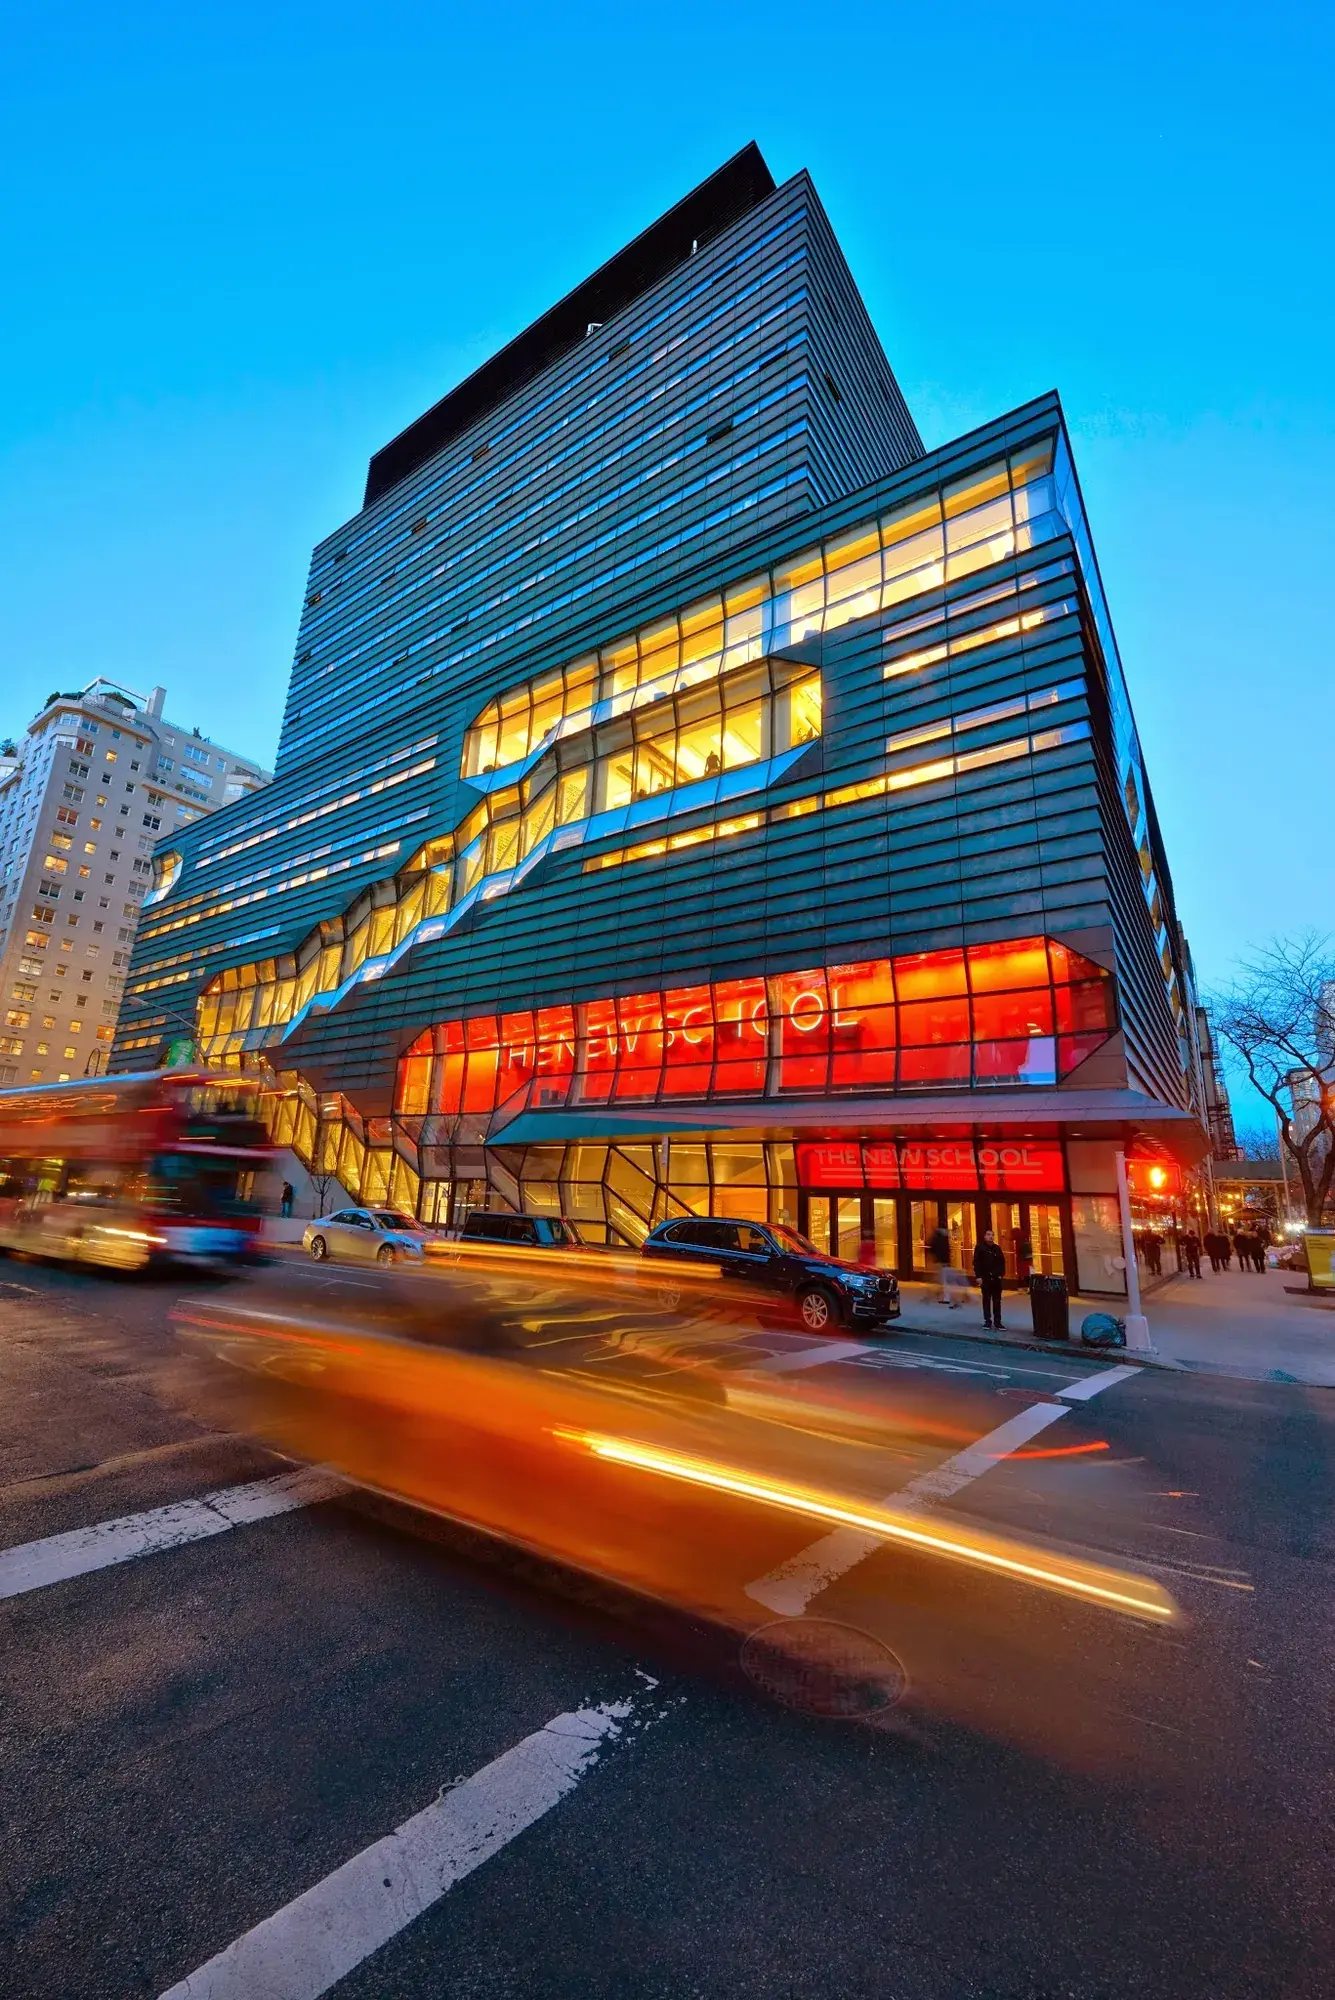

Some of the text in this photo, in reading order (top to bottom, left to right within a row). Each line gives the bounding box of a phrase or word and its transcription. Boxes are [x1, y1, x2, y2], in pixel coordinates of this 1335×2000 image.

[490, 988, 858, 1071] THE NEW SCHOOL
[814, 1148, 1043, 1166] THE NEW SCHOOL
